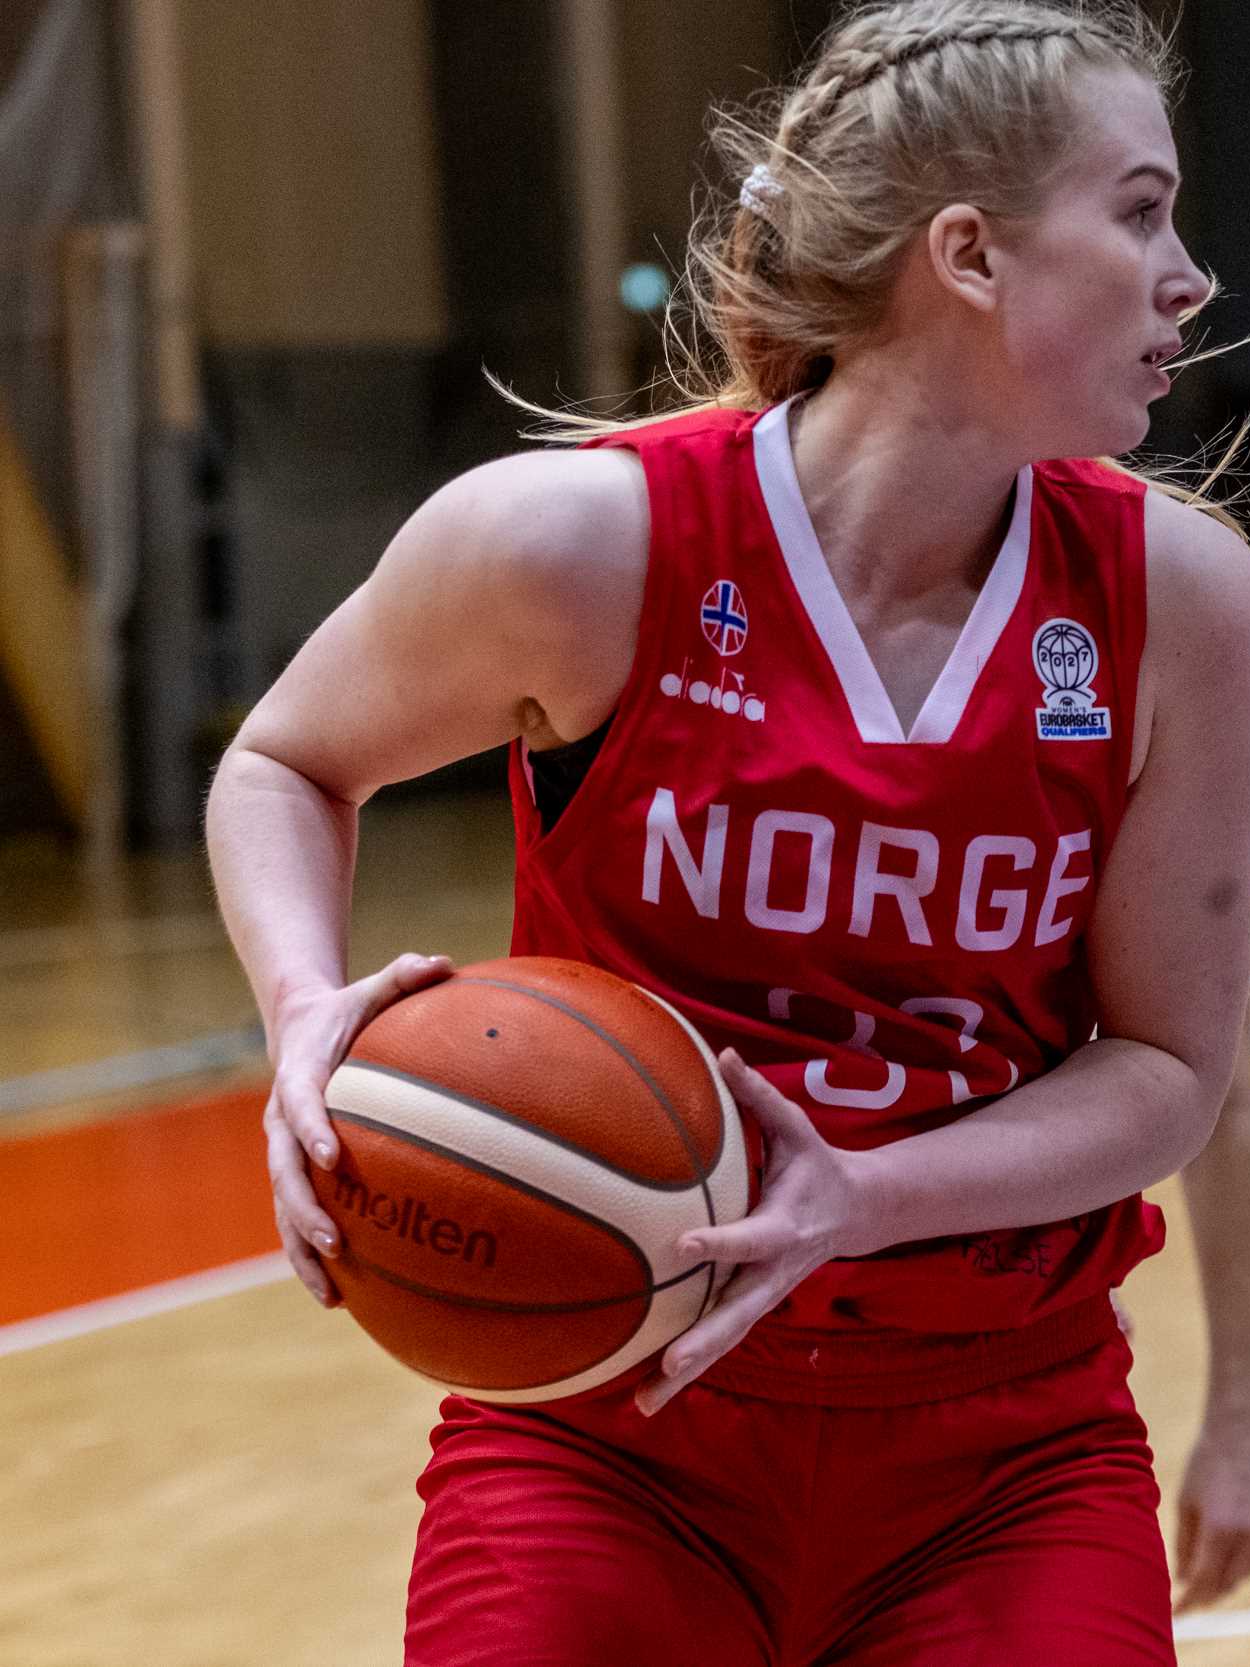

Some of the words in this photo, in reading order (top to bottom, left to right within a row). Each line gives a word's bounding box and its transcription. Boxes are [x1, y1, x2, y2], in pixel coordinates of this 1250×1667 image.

[1040, 651, 1089, 667] 2027
[660, 656, 765, 722] diadora
[1040, 712, 1106, 727] EUROBASKET
[1041, 726, 1107, 736] QUALIFIERS
[641, 787, 1092, 953] NORGE
[334, 1171, 497, 1268] molten
